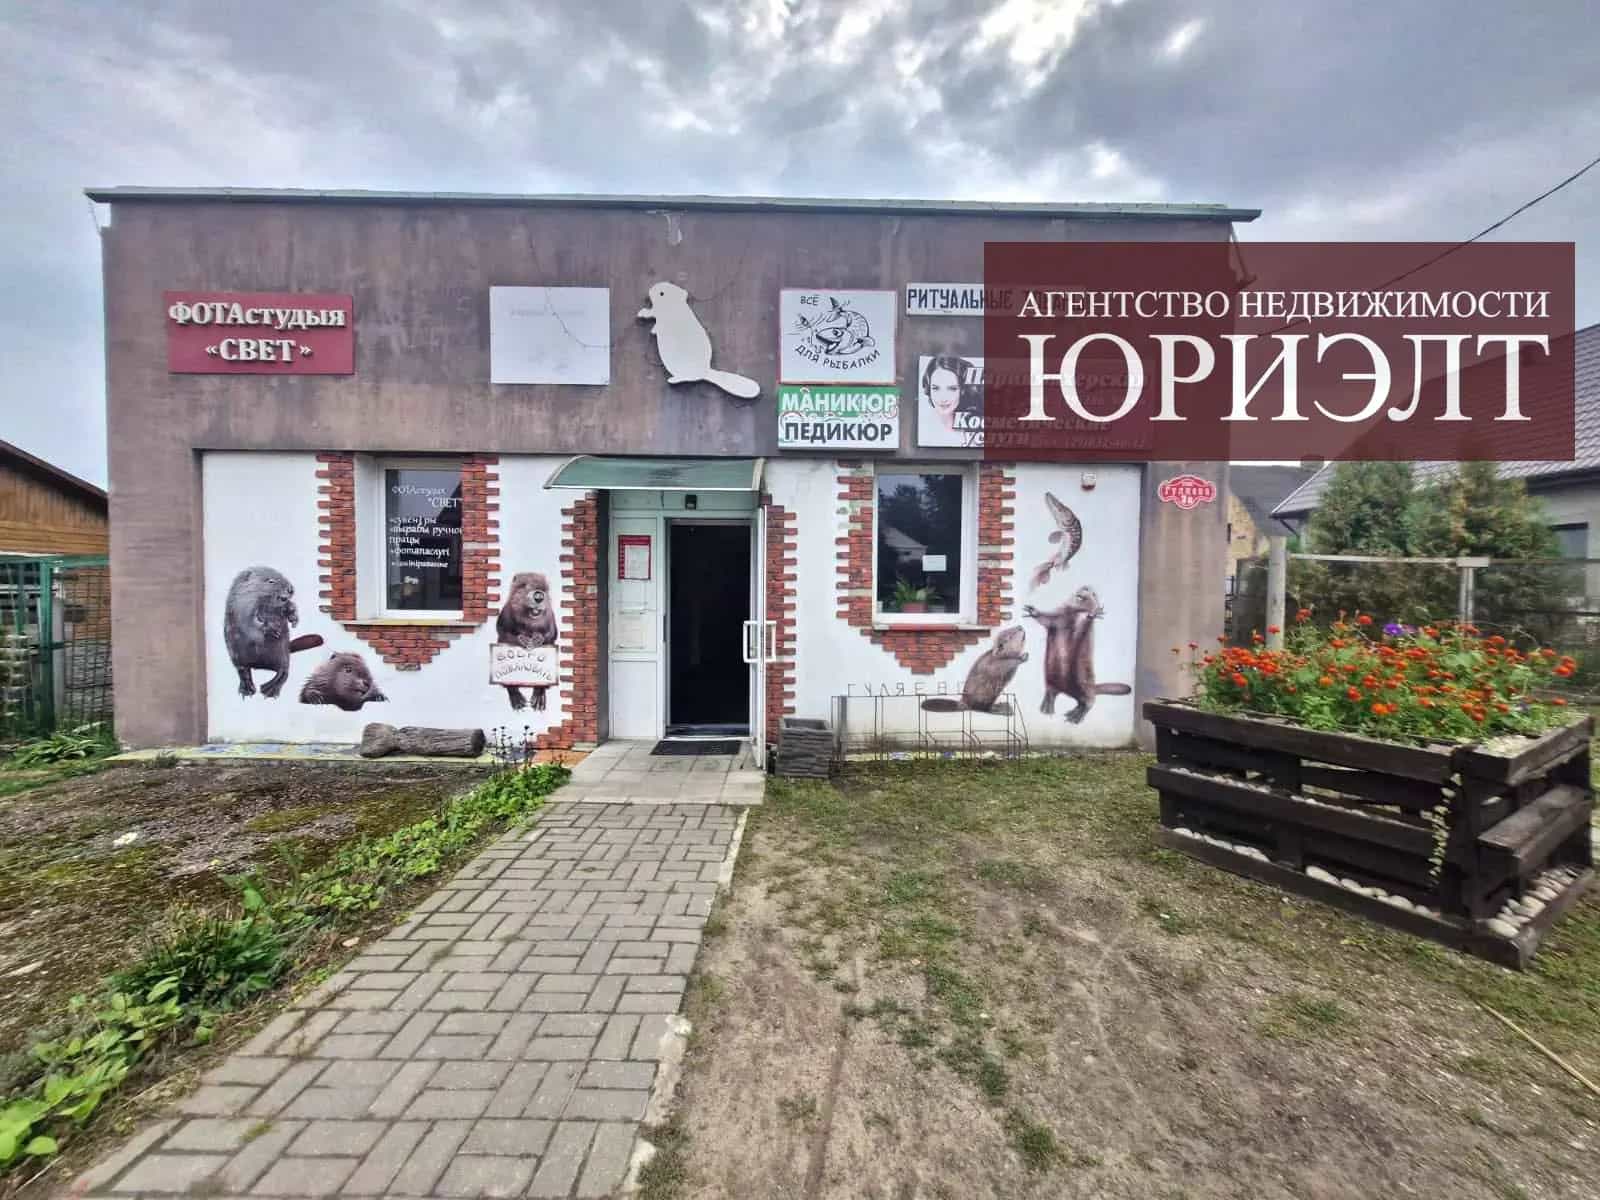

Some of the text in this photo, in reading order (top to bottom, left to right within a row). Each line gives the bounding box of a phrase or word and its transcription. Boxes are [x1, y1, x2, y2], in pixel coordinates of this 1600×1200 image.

[168, 301, 346, 330] ФОТАстудыя
[794, 344, 881, 370] ДЛЯ РЫБАЛКИ
[781, 391, 898, 414] МАНИКЮР
[784, 421, 893, 444] ПЕДИКЮР
